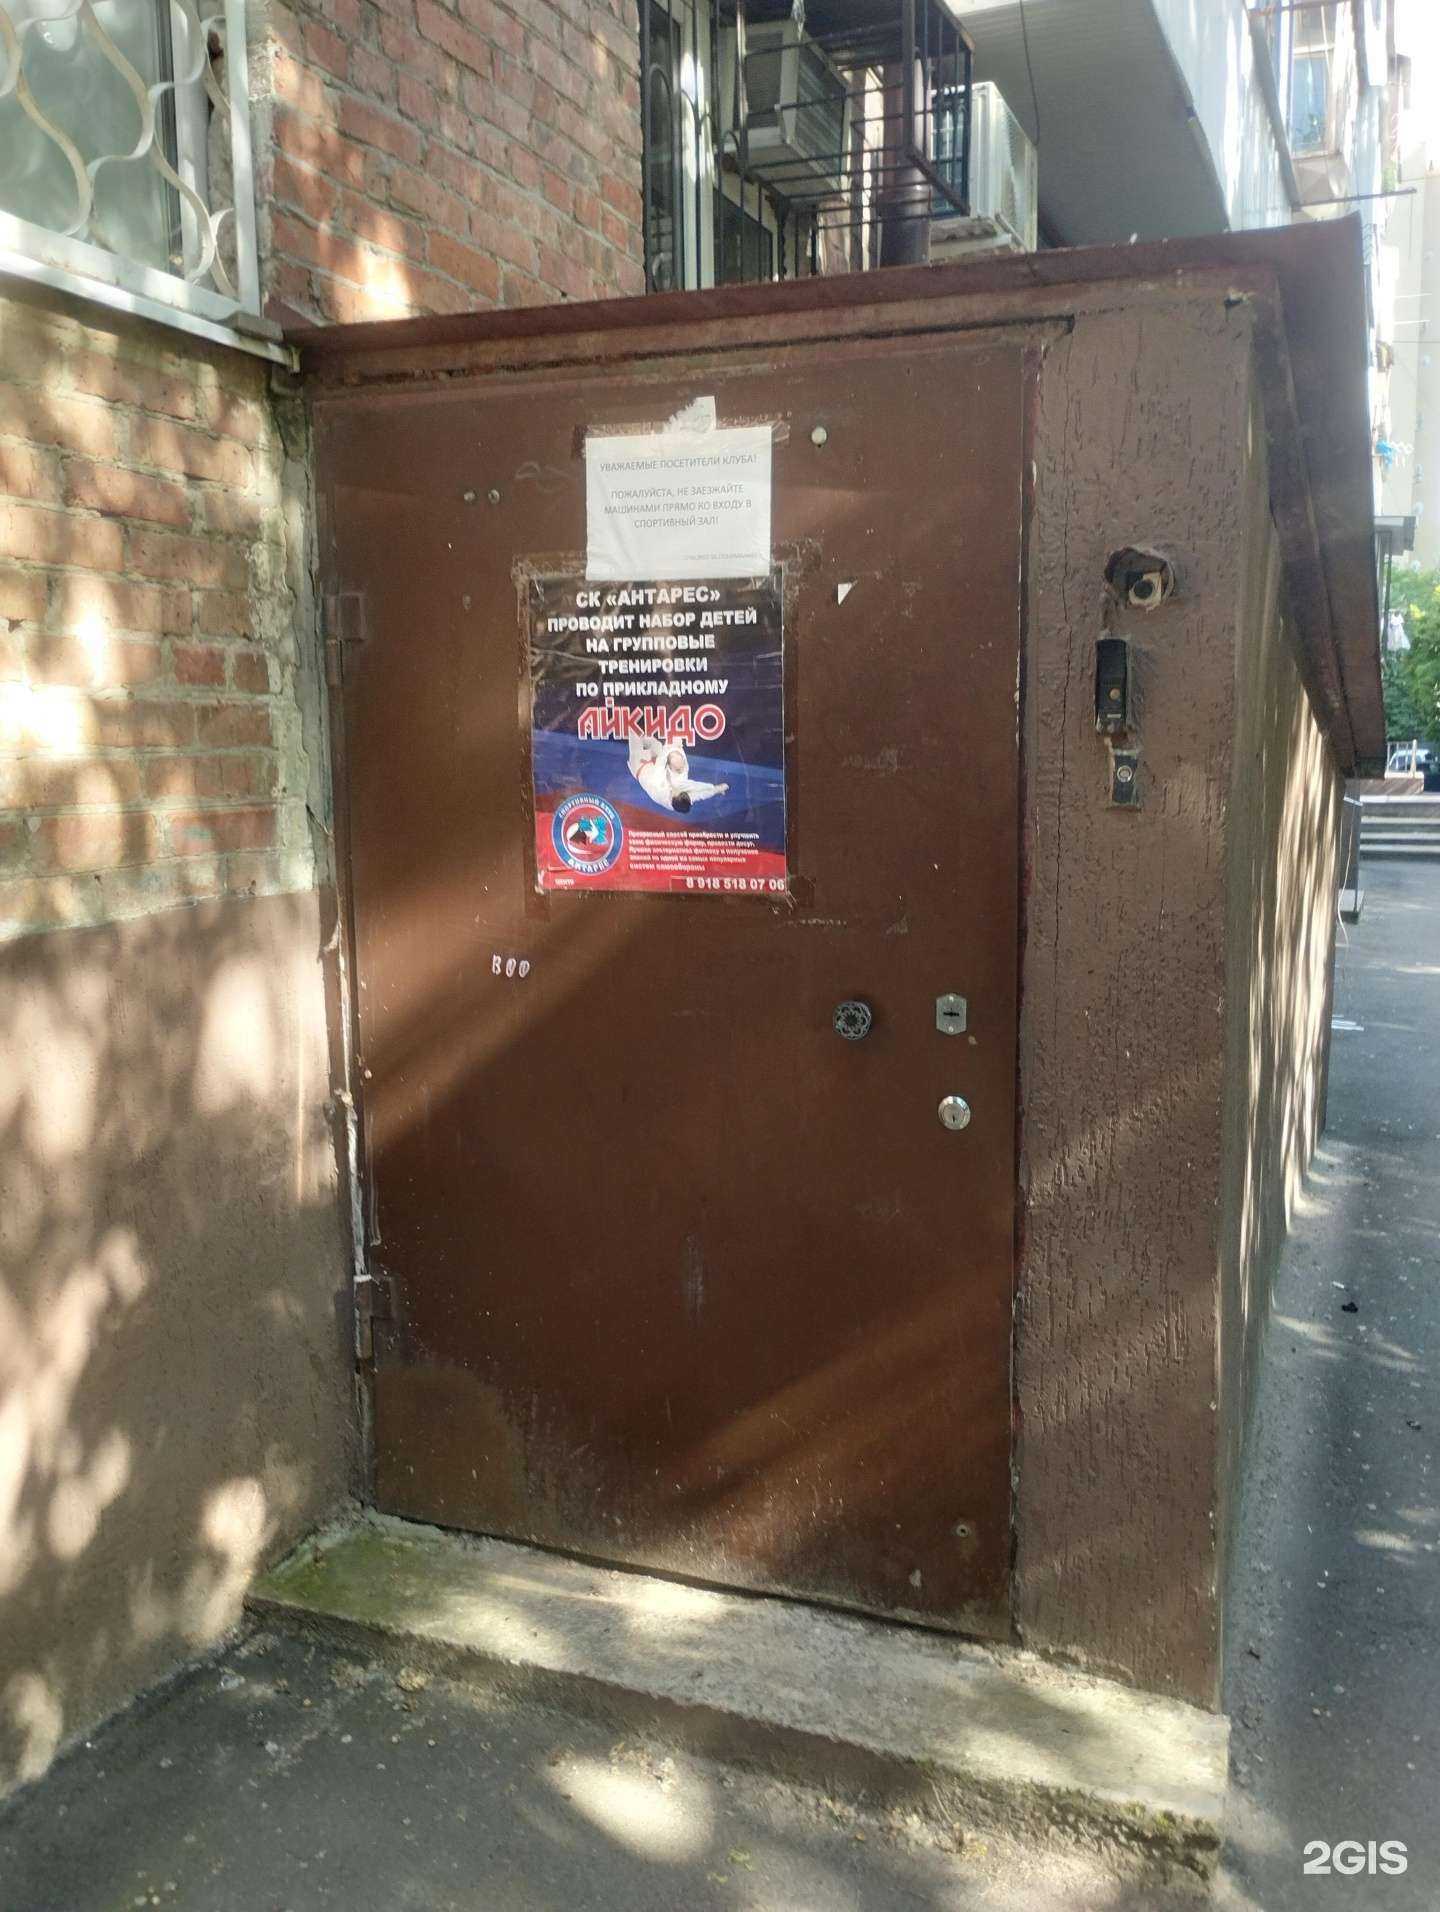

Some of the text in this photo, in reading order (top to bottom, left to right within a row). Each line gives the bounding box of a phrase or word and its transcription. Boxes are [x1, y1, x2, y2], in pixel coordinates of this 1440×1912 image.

[600, 460, 657, 472] УВАЖАЕМЫЕ
[659, 456, 721, 469] ПОСЕТИТЕЛИ
[677, 486, 689, 496] НЕ
[691, 482, 745, 496] ЗАЕЗЖАЙТЕ
[604, 499, 752, 515] МАШИНАМИ ПРЯМО КО ВХОДУ В
[634, 514, 696, 528] СПОРТИВНЫЙ
[576, 585, 721, 608] СК «АНТАРЕС»
[547, 606, 757, 633] ПРОВОДИТ НАБОР ДЕТЕЙ
[586, 634, 716, 653] НА ГРУППОВЫЕ
[598, 657, 708, 674] ТРЕНИРОВКИ
[576, 679, 729, 697] ПО ПРИКЛАДНОМУ
[578, 696, 726, 747] АЙКИДО
[749, 878, 766, 891] 07
[768, 879, 785, 891] 06
